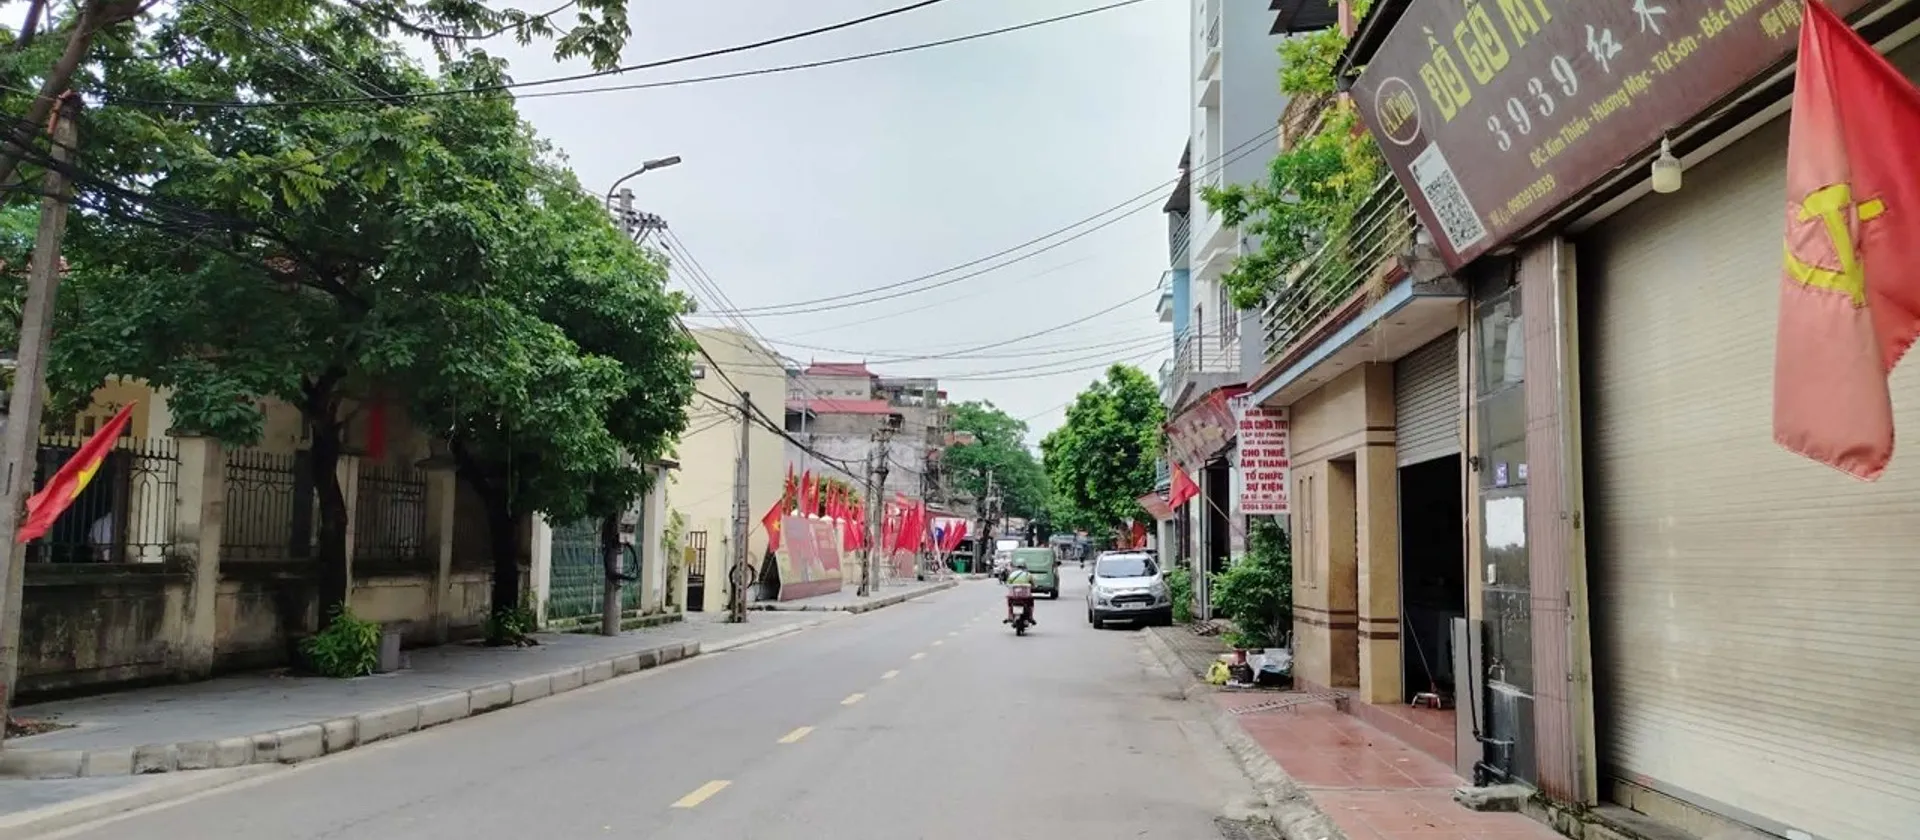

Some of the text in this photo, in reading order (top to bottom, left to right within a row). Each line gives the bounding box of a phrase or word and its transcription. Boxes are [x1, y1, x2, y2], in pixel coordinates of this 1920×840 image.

[1651, 49, 1673, 74] Từ
[1667, 35, 1699, 64] Sơn
[1419, 26, 1472, 123] ĐỒ
[1241, 447, 1286, 457] CHO THUÊ
[1240, 458, 1288, 468] ÂM THANH
[1261, 482, 1284, 493] KIỆN
